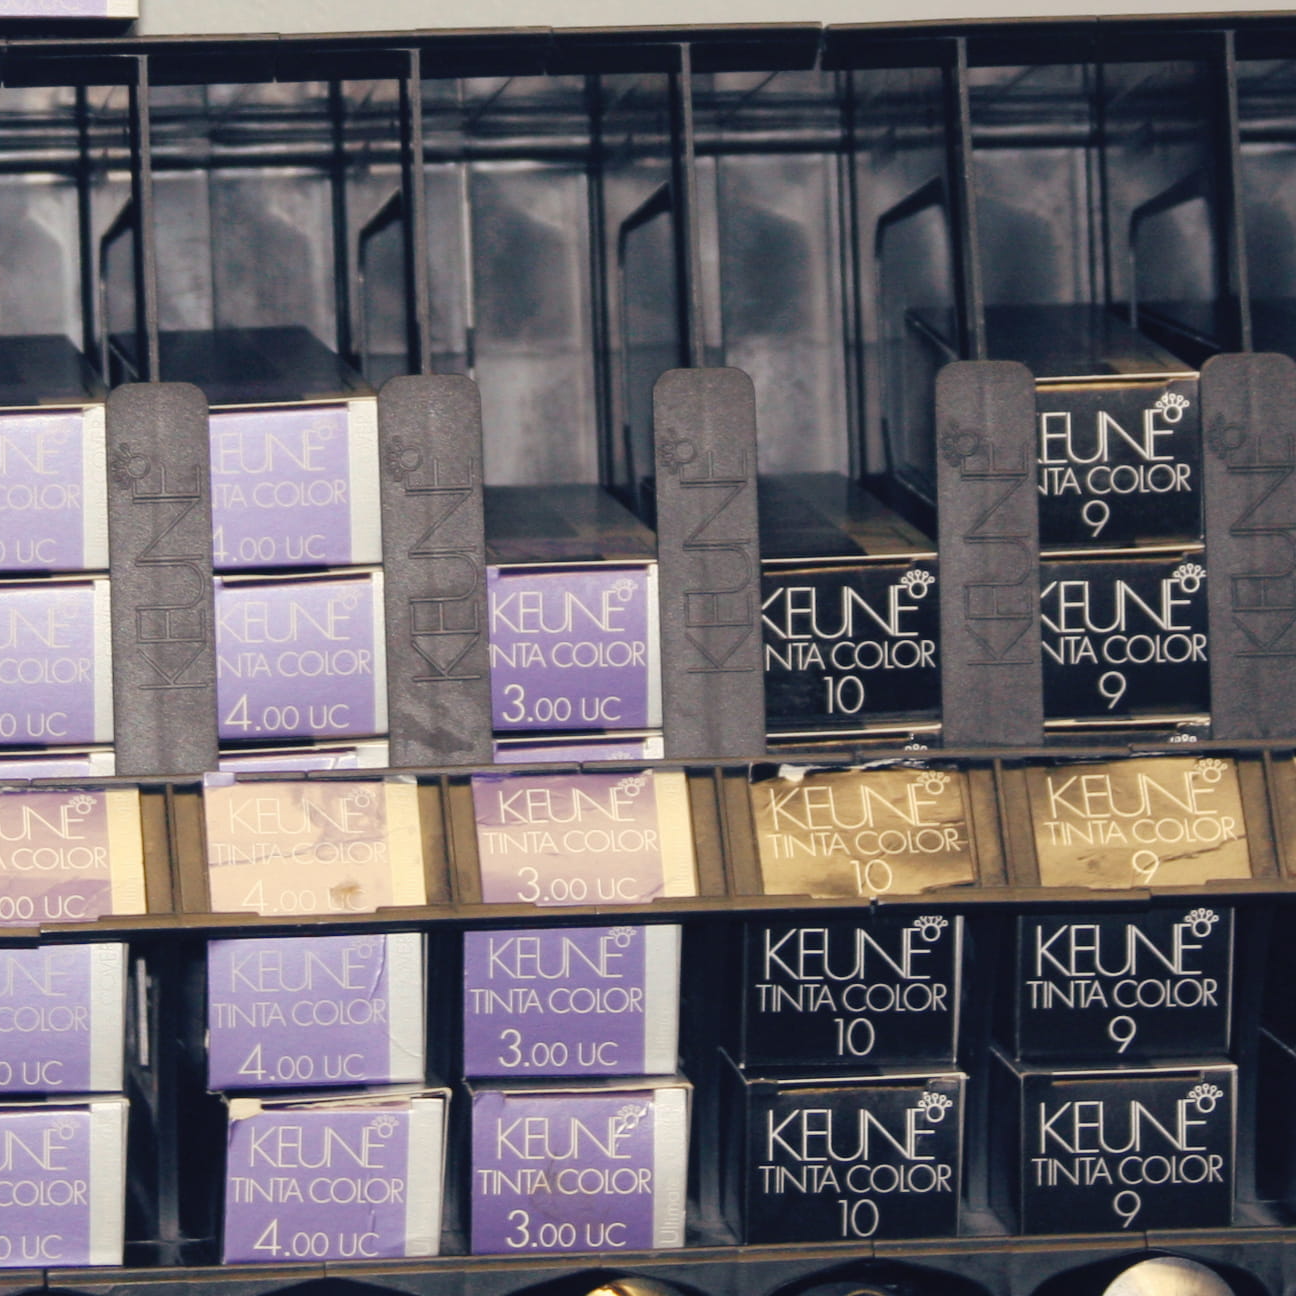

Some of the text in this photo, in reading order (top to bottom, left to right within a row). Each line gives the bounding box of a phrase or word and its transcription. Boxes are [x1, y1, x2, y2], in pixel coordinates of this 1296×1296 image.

[499, 787, 640, 823] KEUNE
[768, 786, 940, 829] KEUNE
[482, 829, 658, 854] TINTA COLOR
[767, 829, 960, 857] TINTA COLOR
[516, 867, 637, 902] 3.00 UC
[854, 861, 893, 893] 10
[487, 938, 626, 979] KEUNE
[1035, 925, 1202, 976] KEUNE
[470, 987, 643, 1014] TINTA COLOR
[1026, 980, 1217, 1009] TINTA COLOR
[499, 1030, 618, 1067] 3.00 UC
[1108, 1018, 1136, 1054] 9
[768, 1110, 935, 1161] KEUNE
[759, 1165, 951, 1194] TINTA COLOR
[837, 1199, 879, 1237] 10
